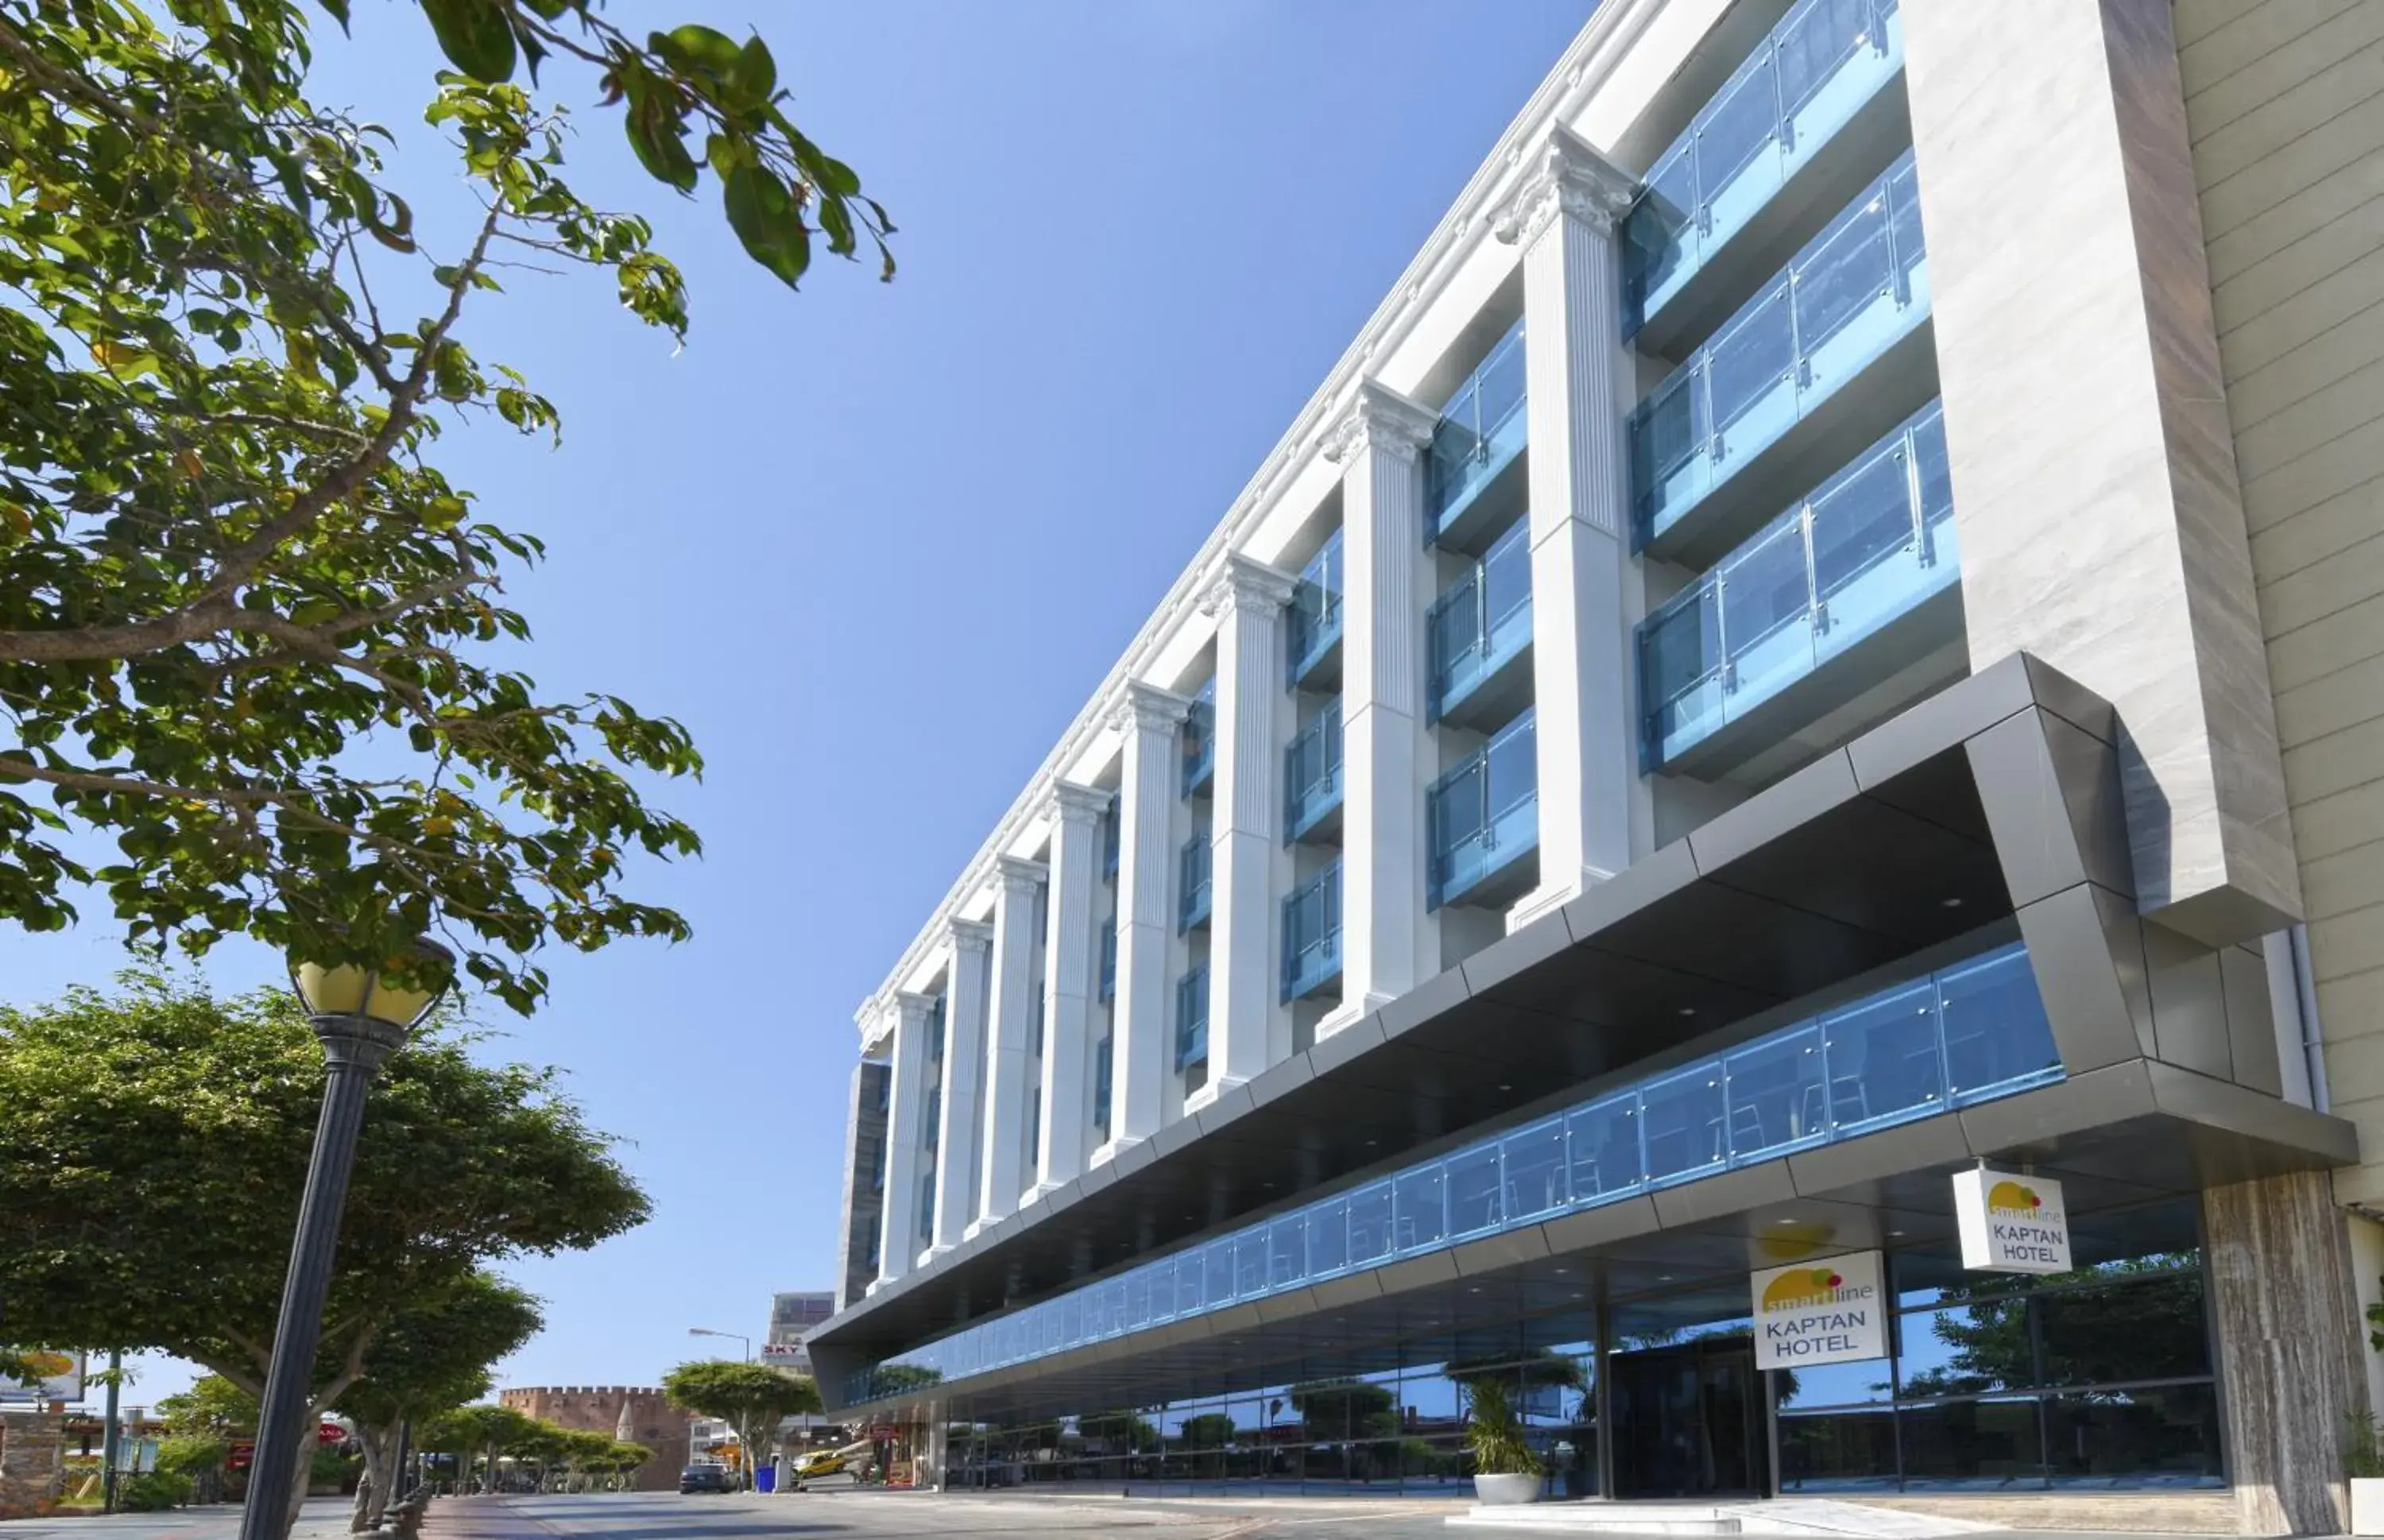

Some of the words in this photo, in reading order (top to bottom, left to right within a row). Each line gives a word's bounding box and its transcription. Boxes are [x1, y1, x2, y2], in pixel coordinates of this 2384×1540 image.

[1994, 1225, 2063, 1244] KAPTAN
[2003, 1244, 2058, 1263] HOTEL
[1767, 1285, 1873, 1311] smartline
[1767, 1311, 1865, 1339] KAPTAN
[1776, 1335, 1858, 1357] HOTEL
